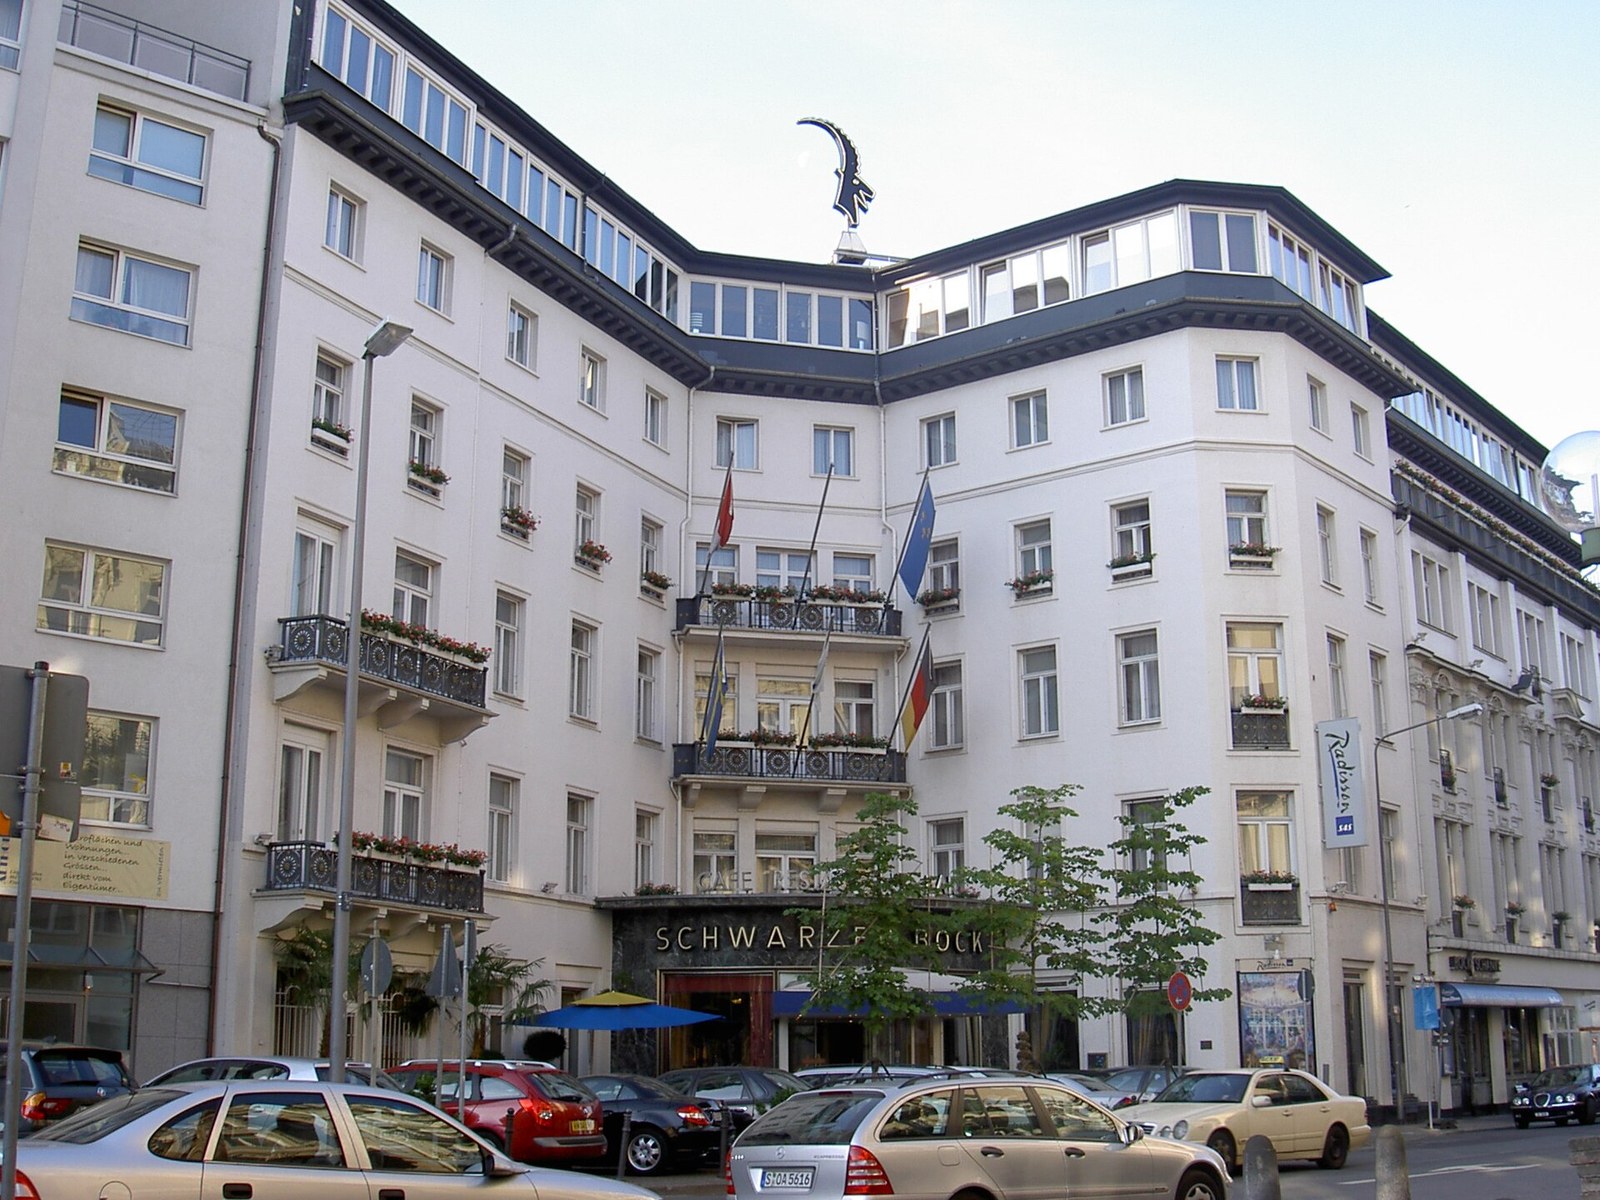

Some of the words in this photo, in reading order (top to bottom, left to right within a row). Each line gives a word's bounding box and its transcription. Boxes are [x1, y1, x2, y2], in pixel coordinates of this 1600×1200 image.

[1325, 730, 1356, 814] Radisson
[1338, 824, 1352, 832] SAS
[123, 839, 142, 847] und
[64, 851, 75, 860] in
[63, 872, 91, 881] direkt
[656, 926, 892, 951] SCHWARZE
[914, 928, 983, 953] BOCK
[765, 1173, 771, 1185] S
[789, 1173, 810, 1185] 5616
